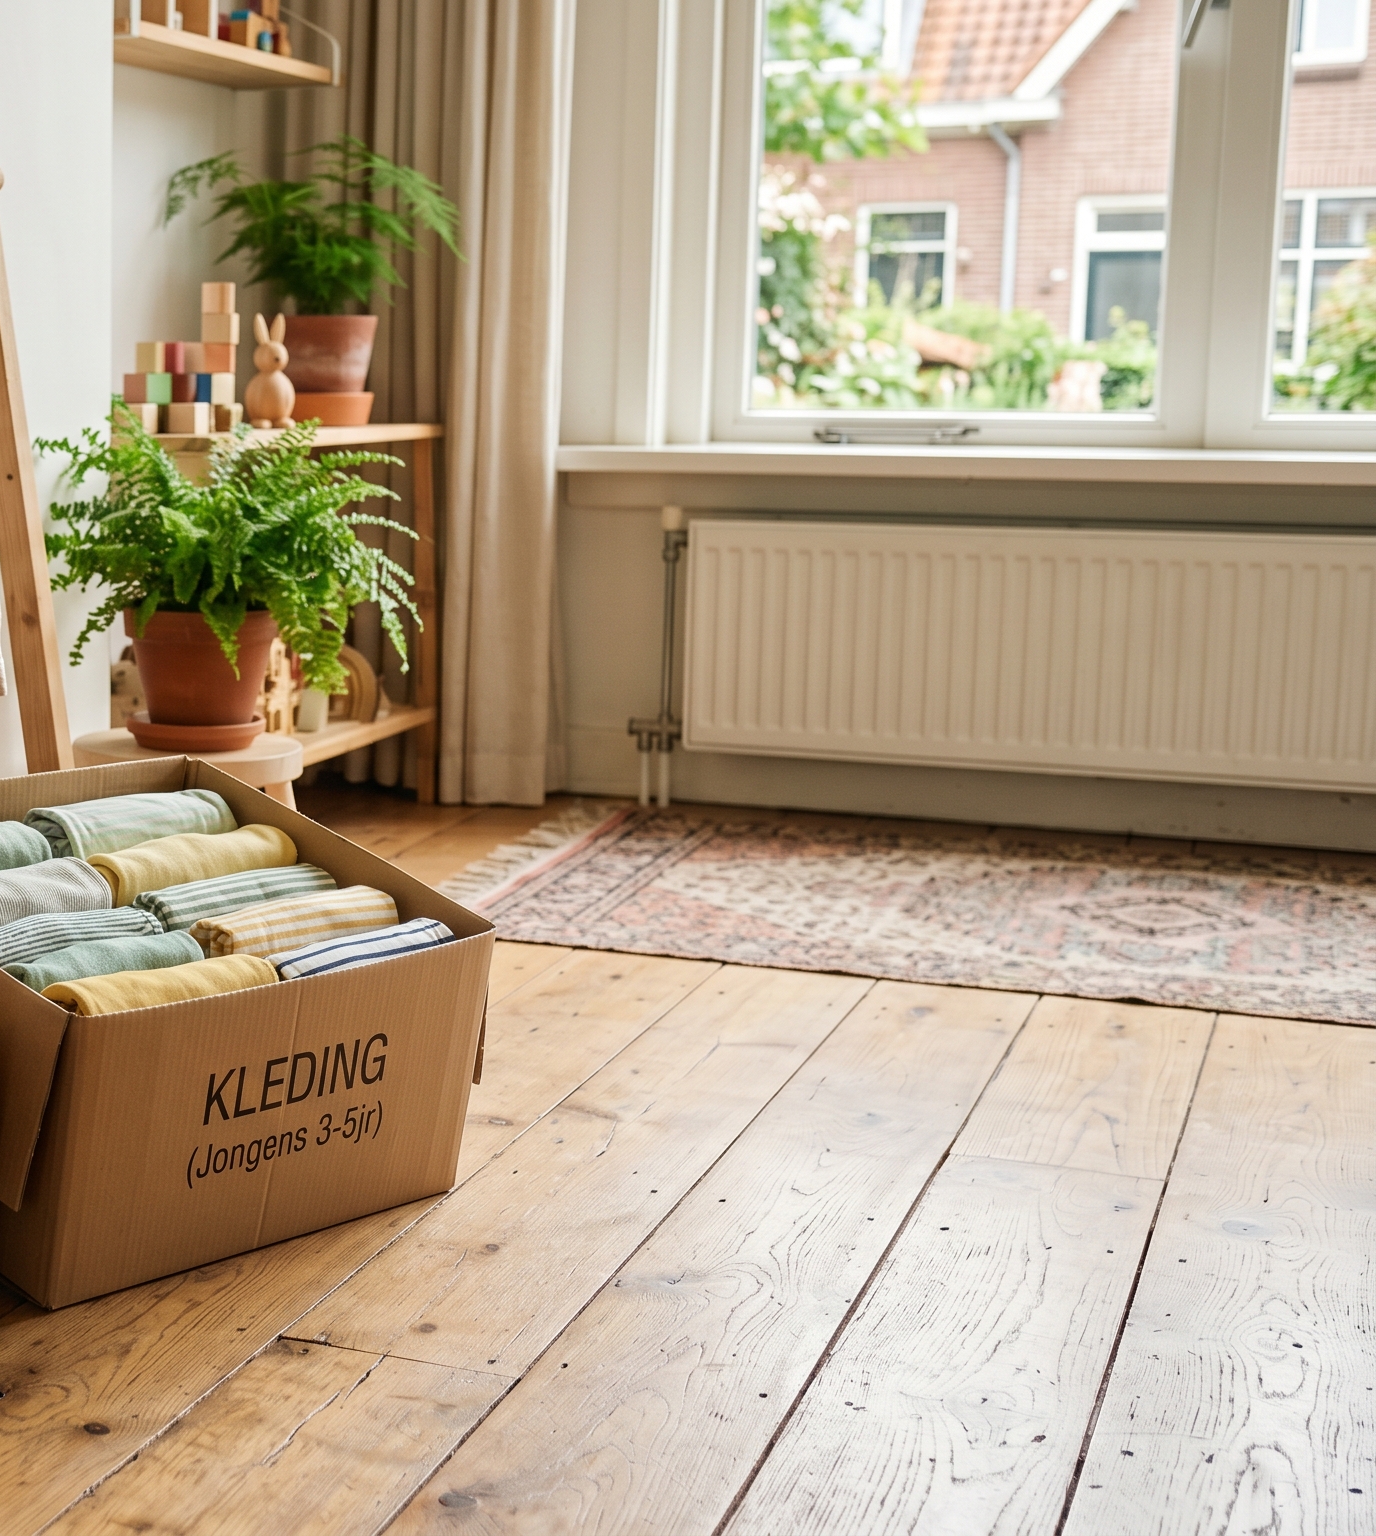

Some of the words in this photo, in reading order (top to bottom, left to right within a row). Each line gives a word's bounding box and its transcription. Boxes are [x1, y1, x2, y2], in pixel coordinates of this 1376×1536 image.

[203, 1033, 388, 1126] KLEDING
[186, 1126, 308, 1189] (Jongens
[316, 1100, 383, 1146] 3-5jr)
